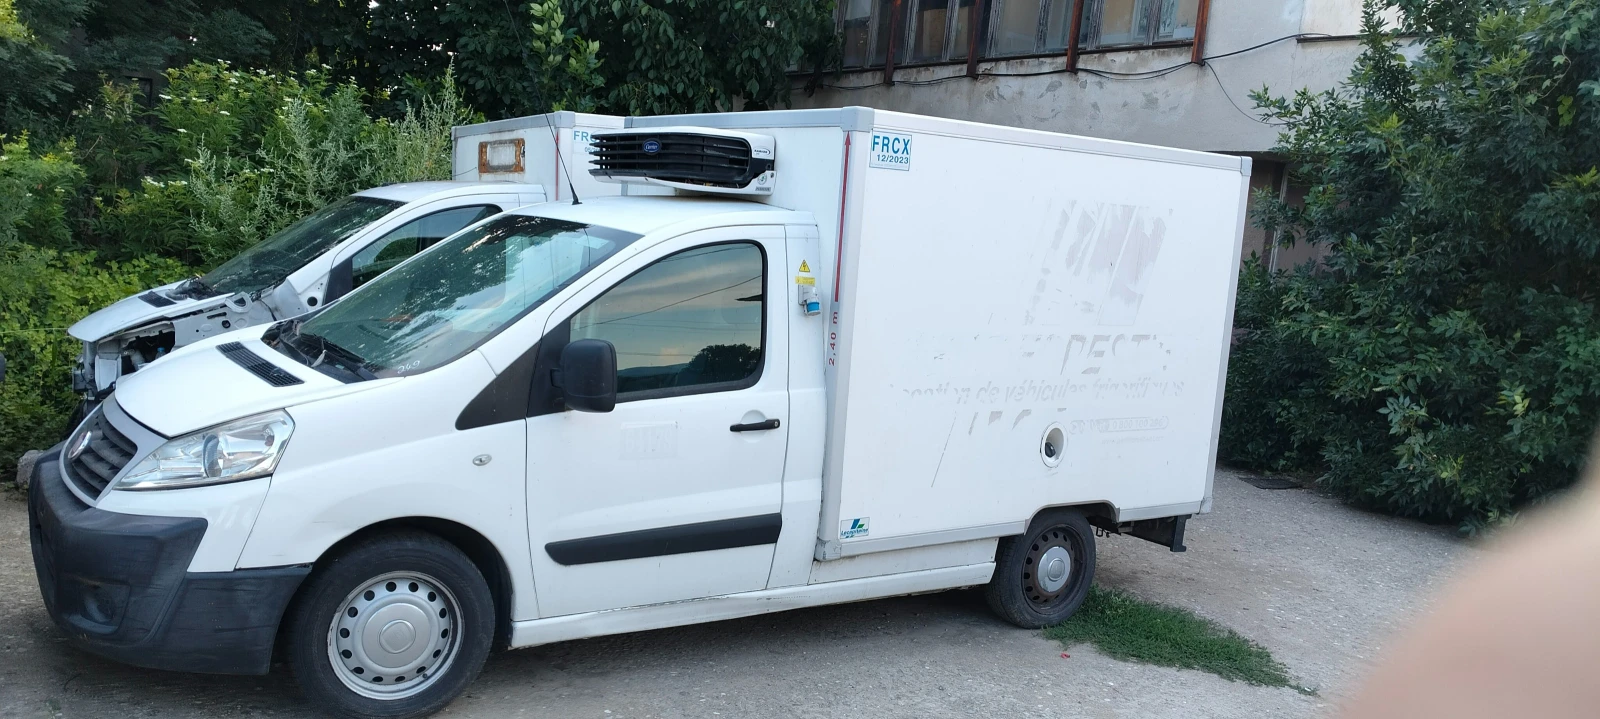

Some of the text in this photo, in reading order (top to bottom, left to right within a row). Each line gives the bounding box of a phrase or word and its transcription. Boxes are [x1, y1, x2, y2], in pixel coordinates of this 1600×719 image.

[872, 135, 910, 155] FRCX
[876, 154, 909, 165] 12/2023
[828, 332, 837, 366] 2,40
